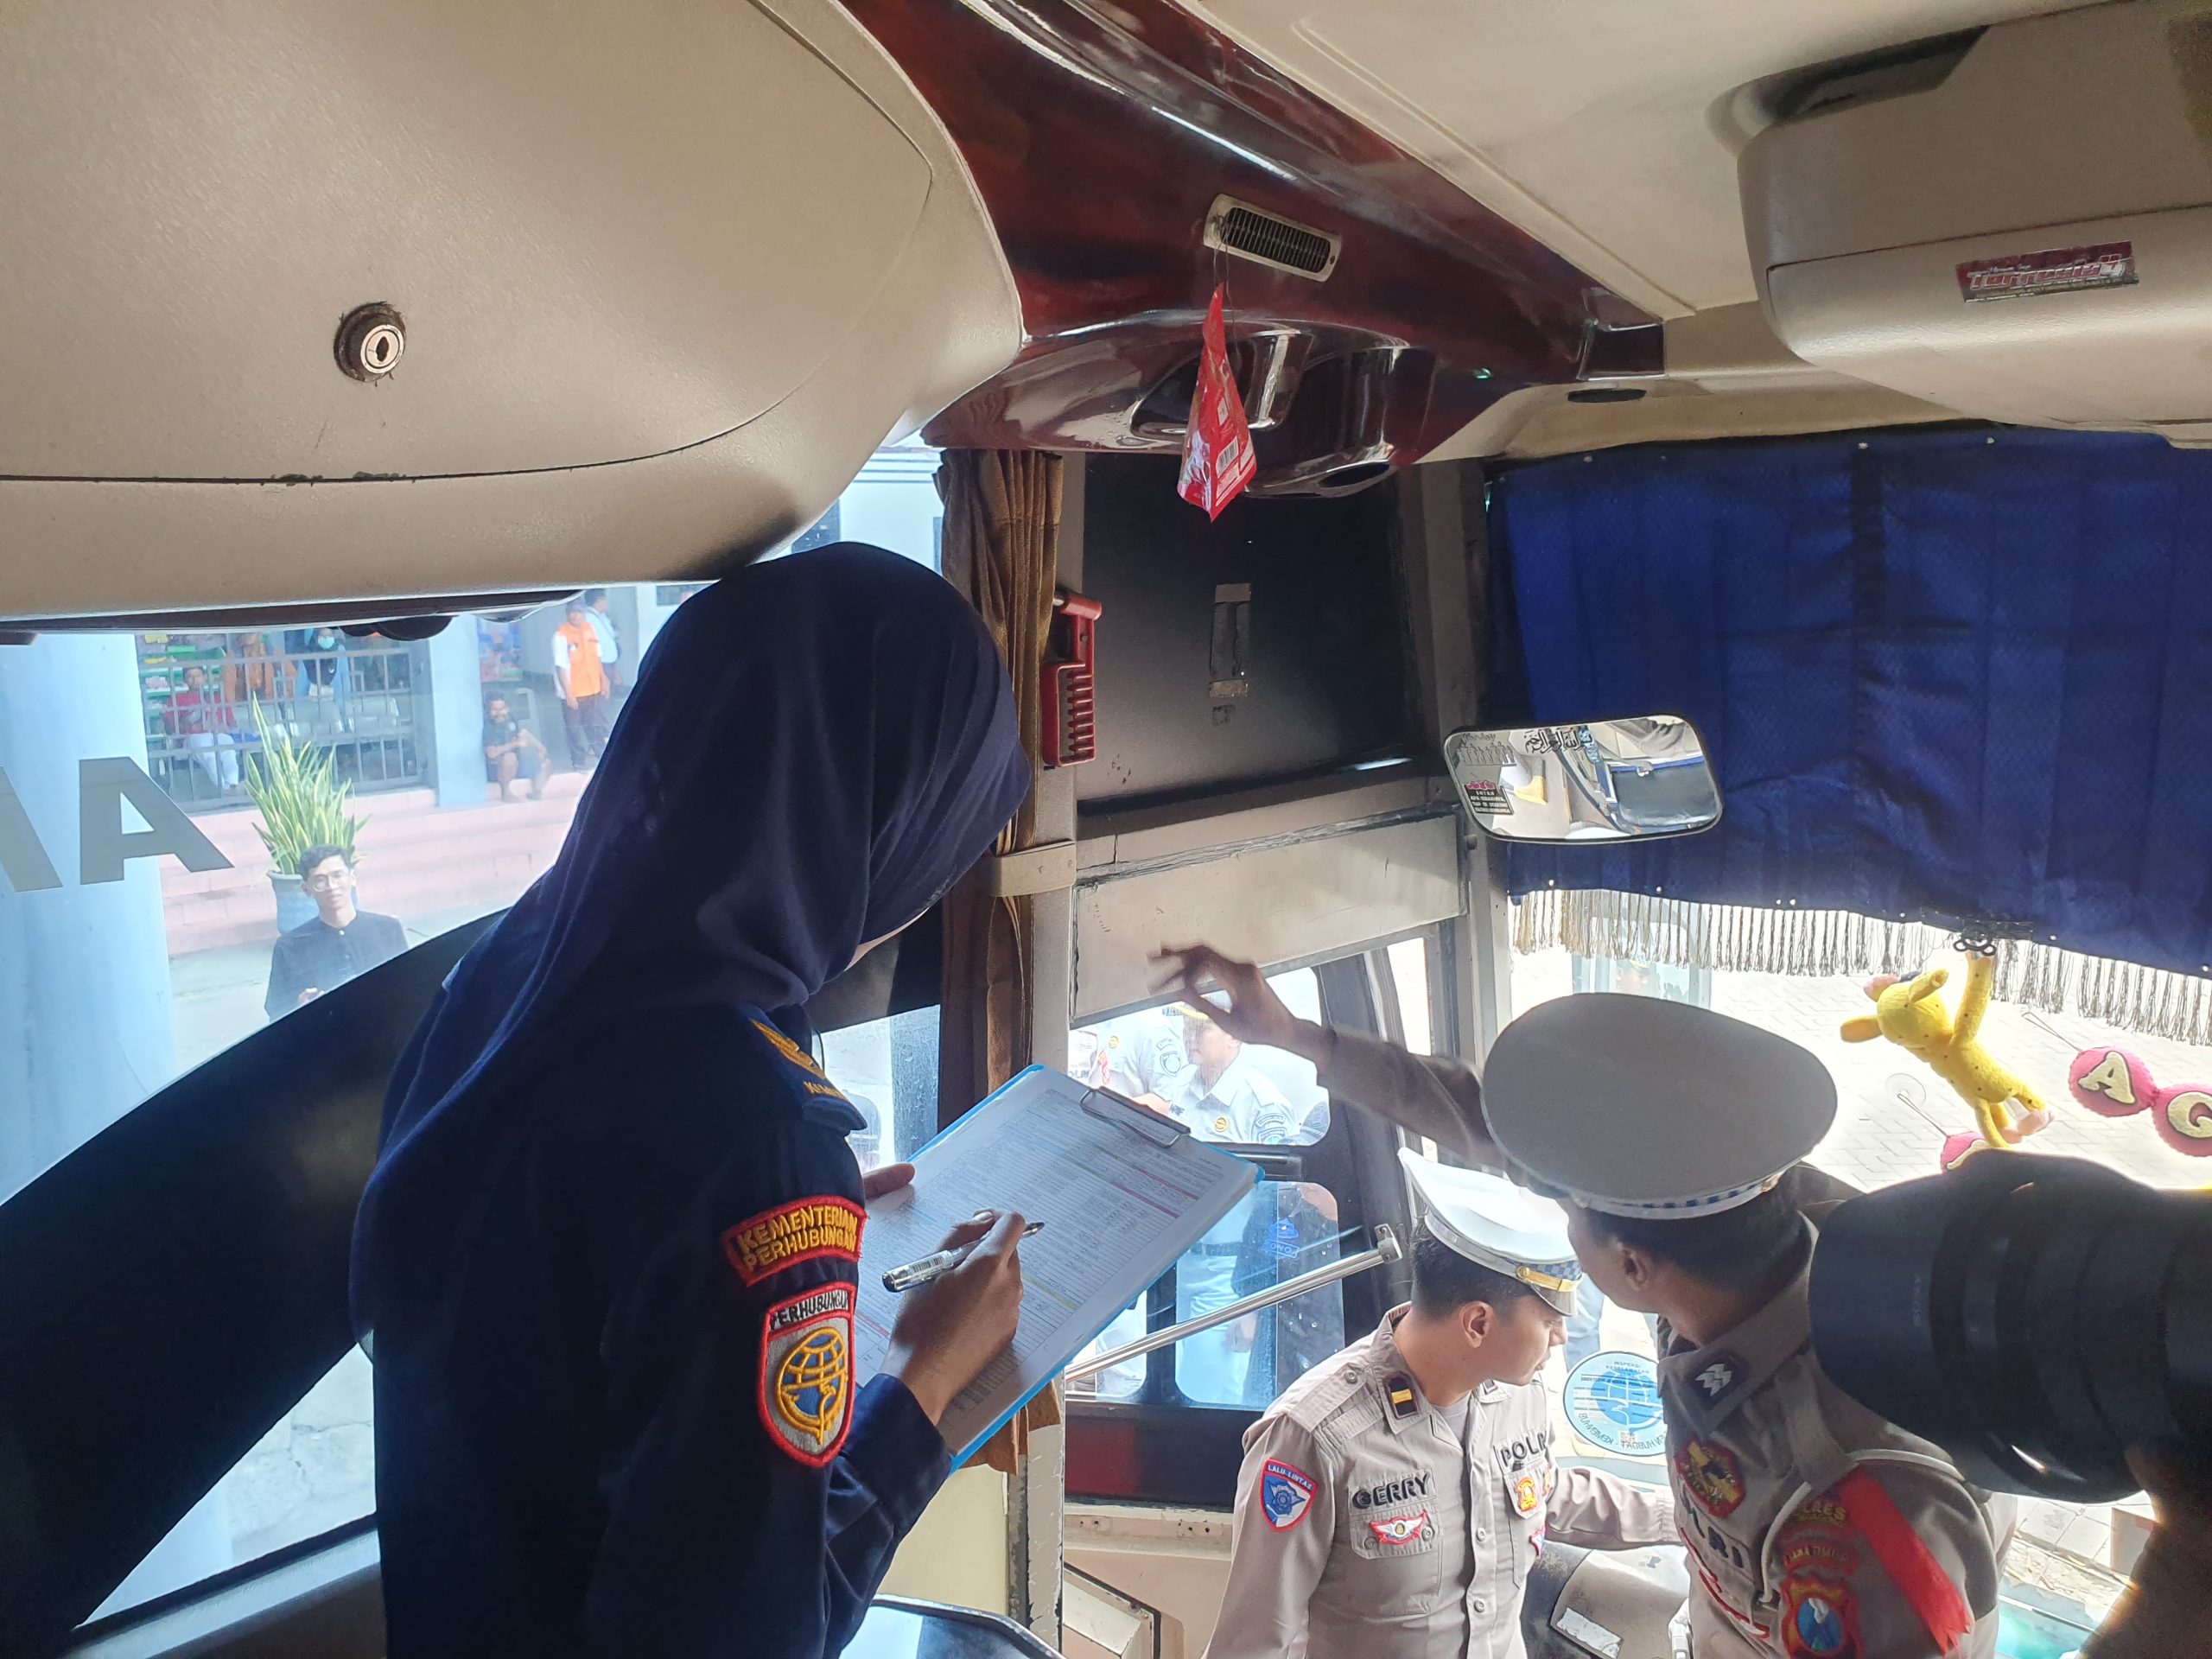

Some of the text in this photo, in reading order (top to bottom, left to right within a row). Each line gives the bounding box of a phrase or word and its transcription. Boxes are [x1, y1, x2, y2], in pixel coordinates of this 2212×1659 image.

[738, 1205, 857, 1253] KEMENTERIAN
[743, 1225, 857, 1271] PERHUBUNGAN
[1501, 1431, 1547, 1467] POLR
[1268, 1463, 1313, 1490] LALU LINTAS
[1352, 1472, 1430, 1509] GERRY
